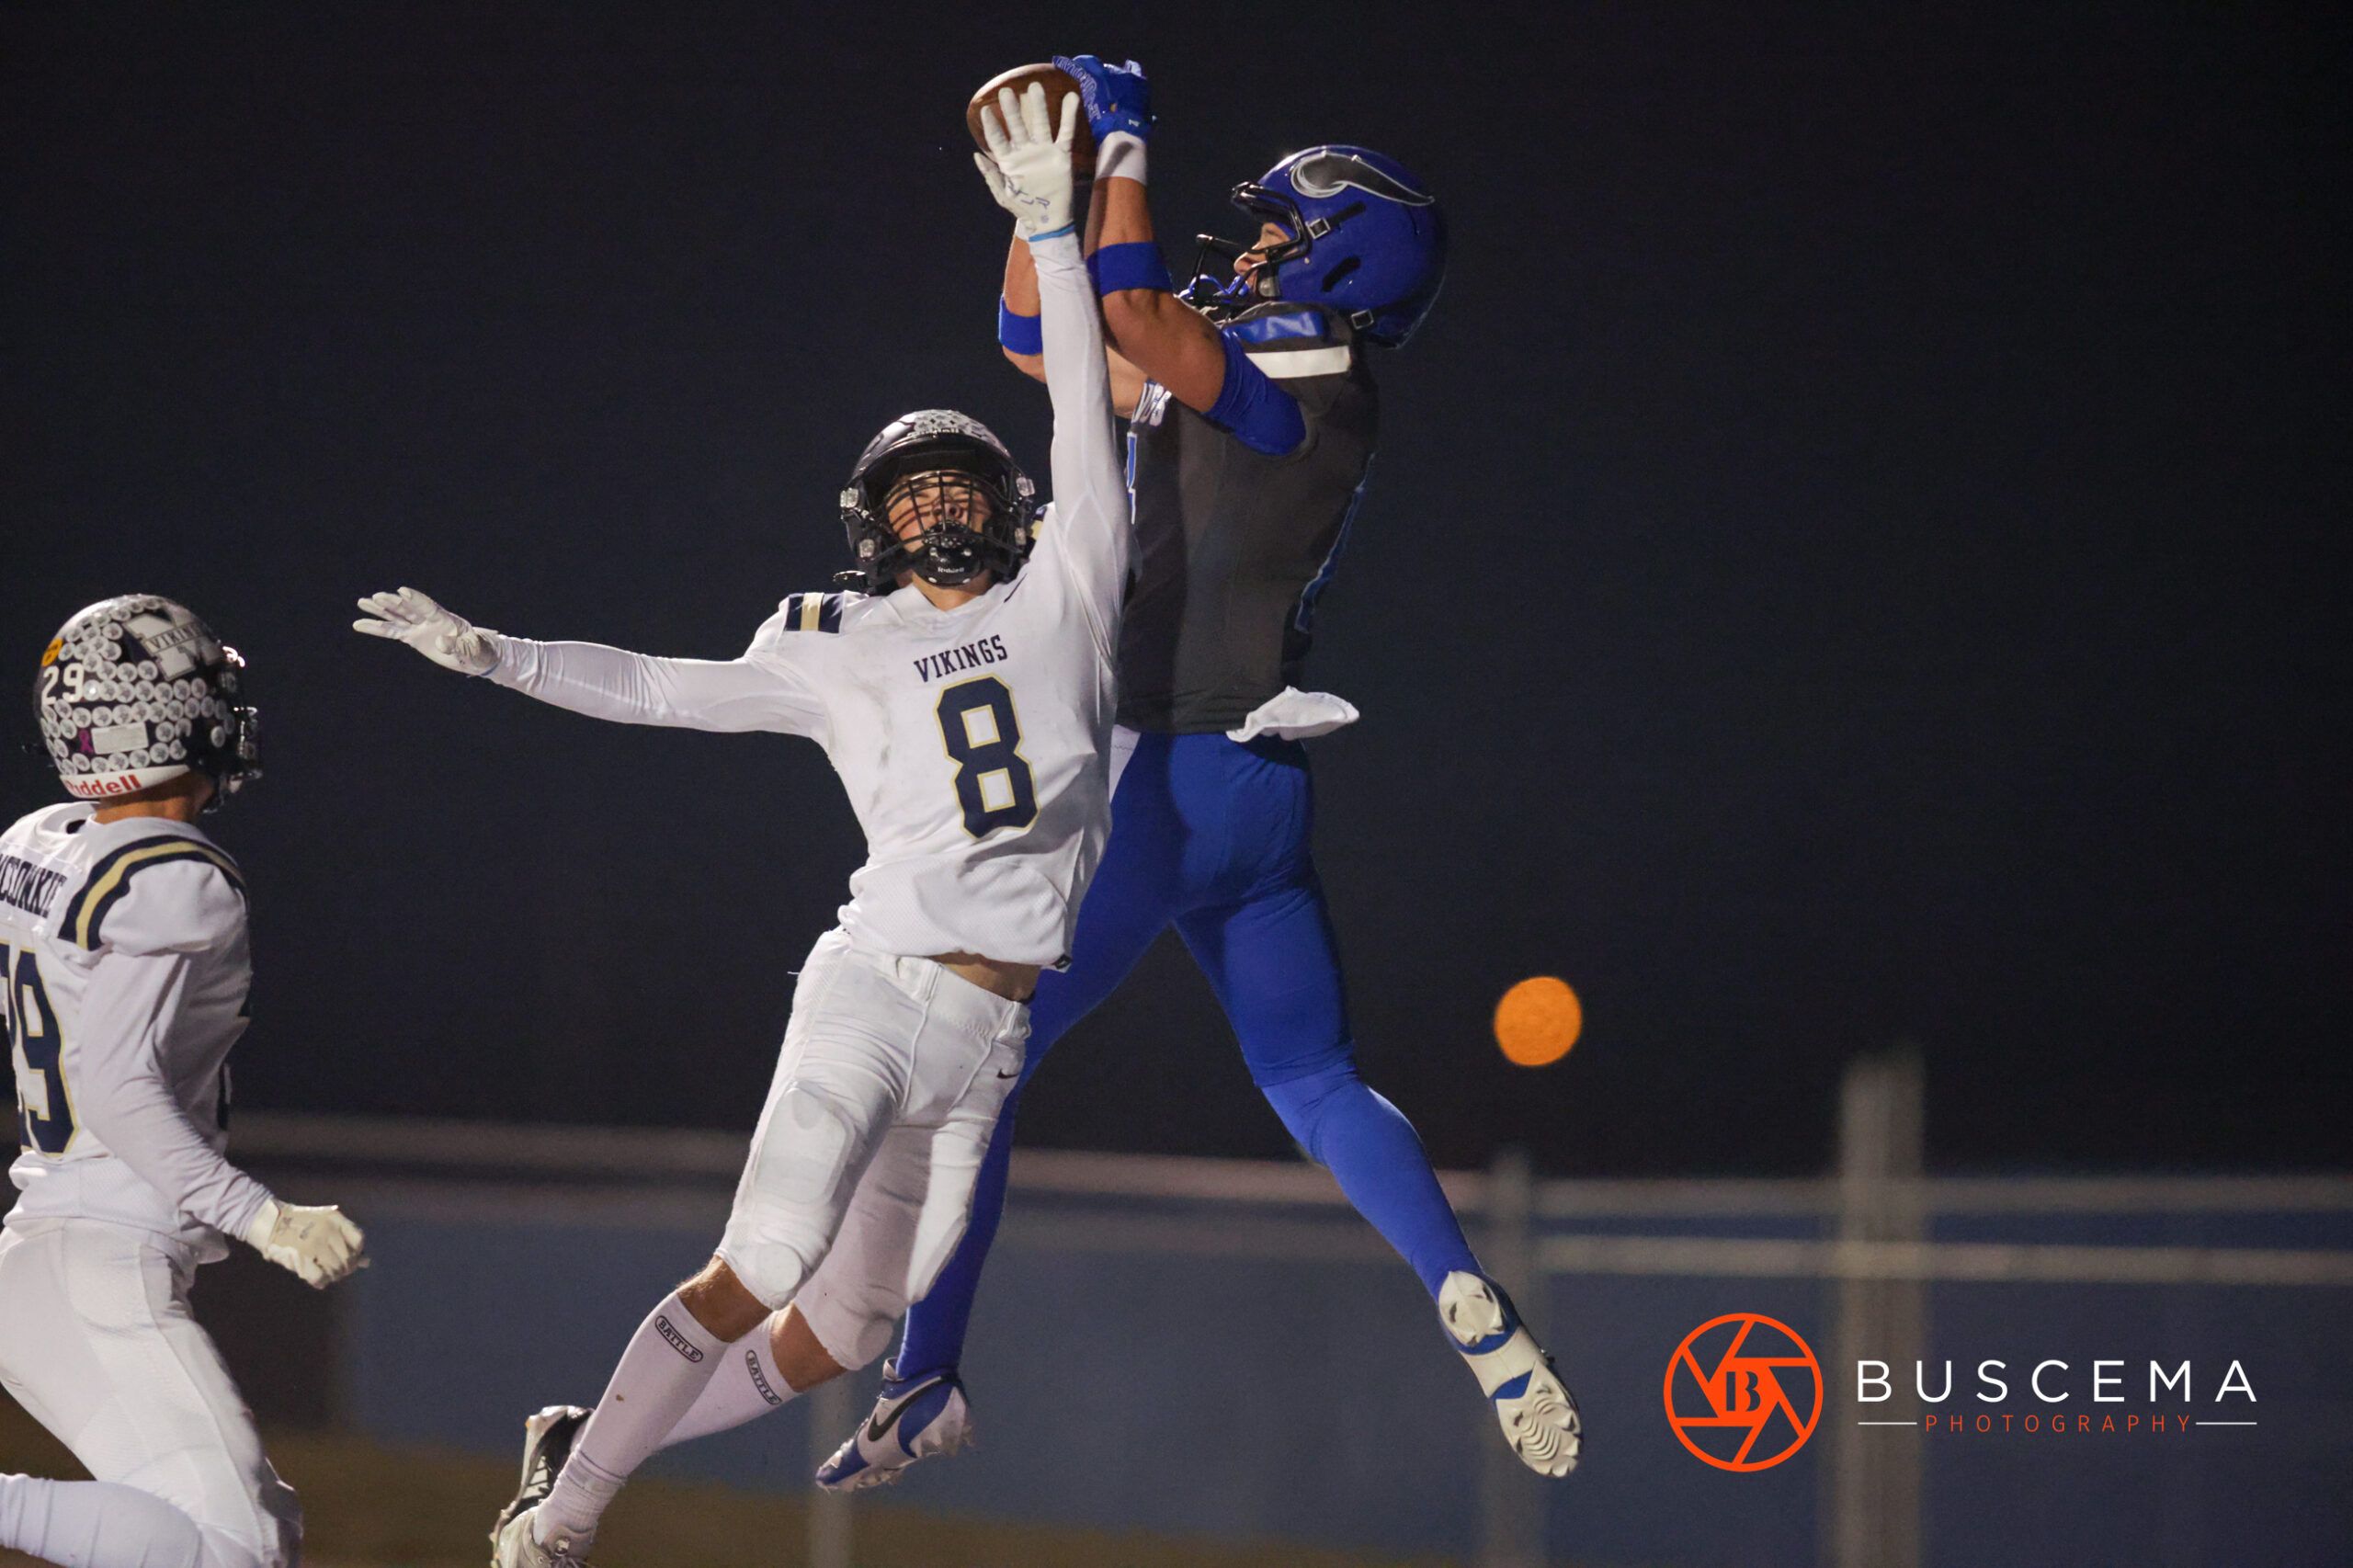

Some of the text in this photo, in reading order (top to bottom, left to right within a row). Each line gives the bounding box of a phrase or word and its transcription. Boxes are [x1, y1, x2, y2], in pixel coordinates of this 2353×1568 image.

[913, 634, 1007, 683] VIKINGS
[41, 663, 85, 704] 29
[932, 672, 1041, 841] 8
[0, 939, 80, 1158] 9
[657, 1318, 700, 1360] BATTLE
[747, 1356, 779, 1403] BATTLE
